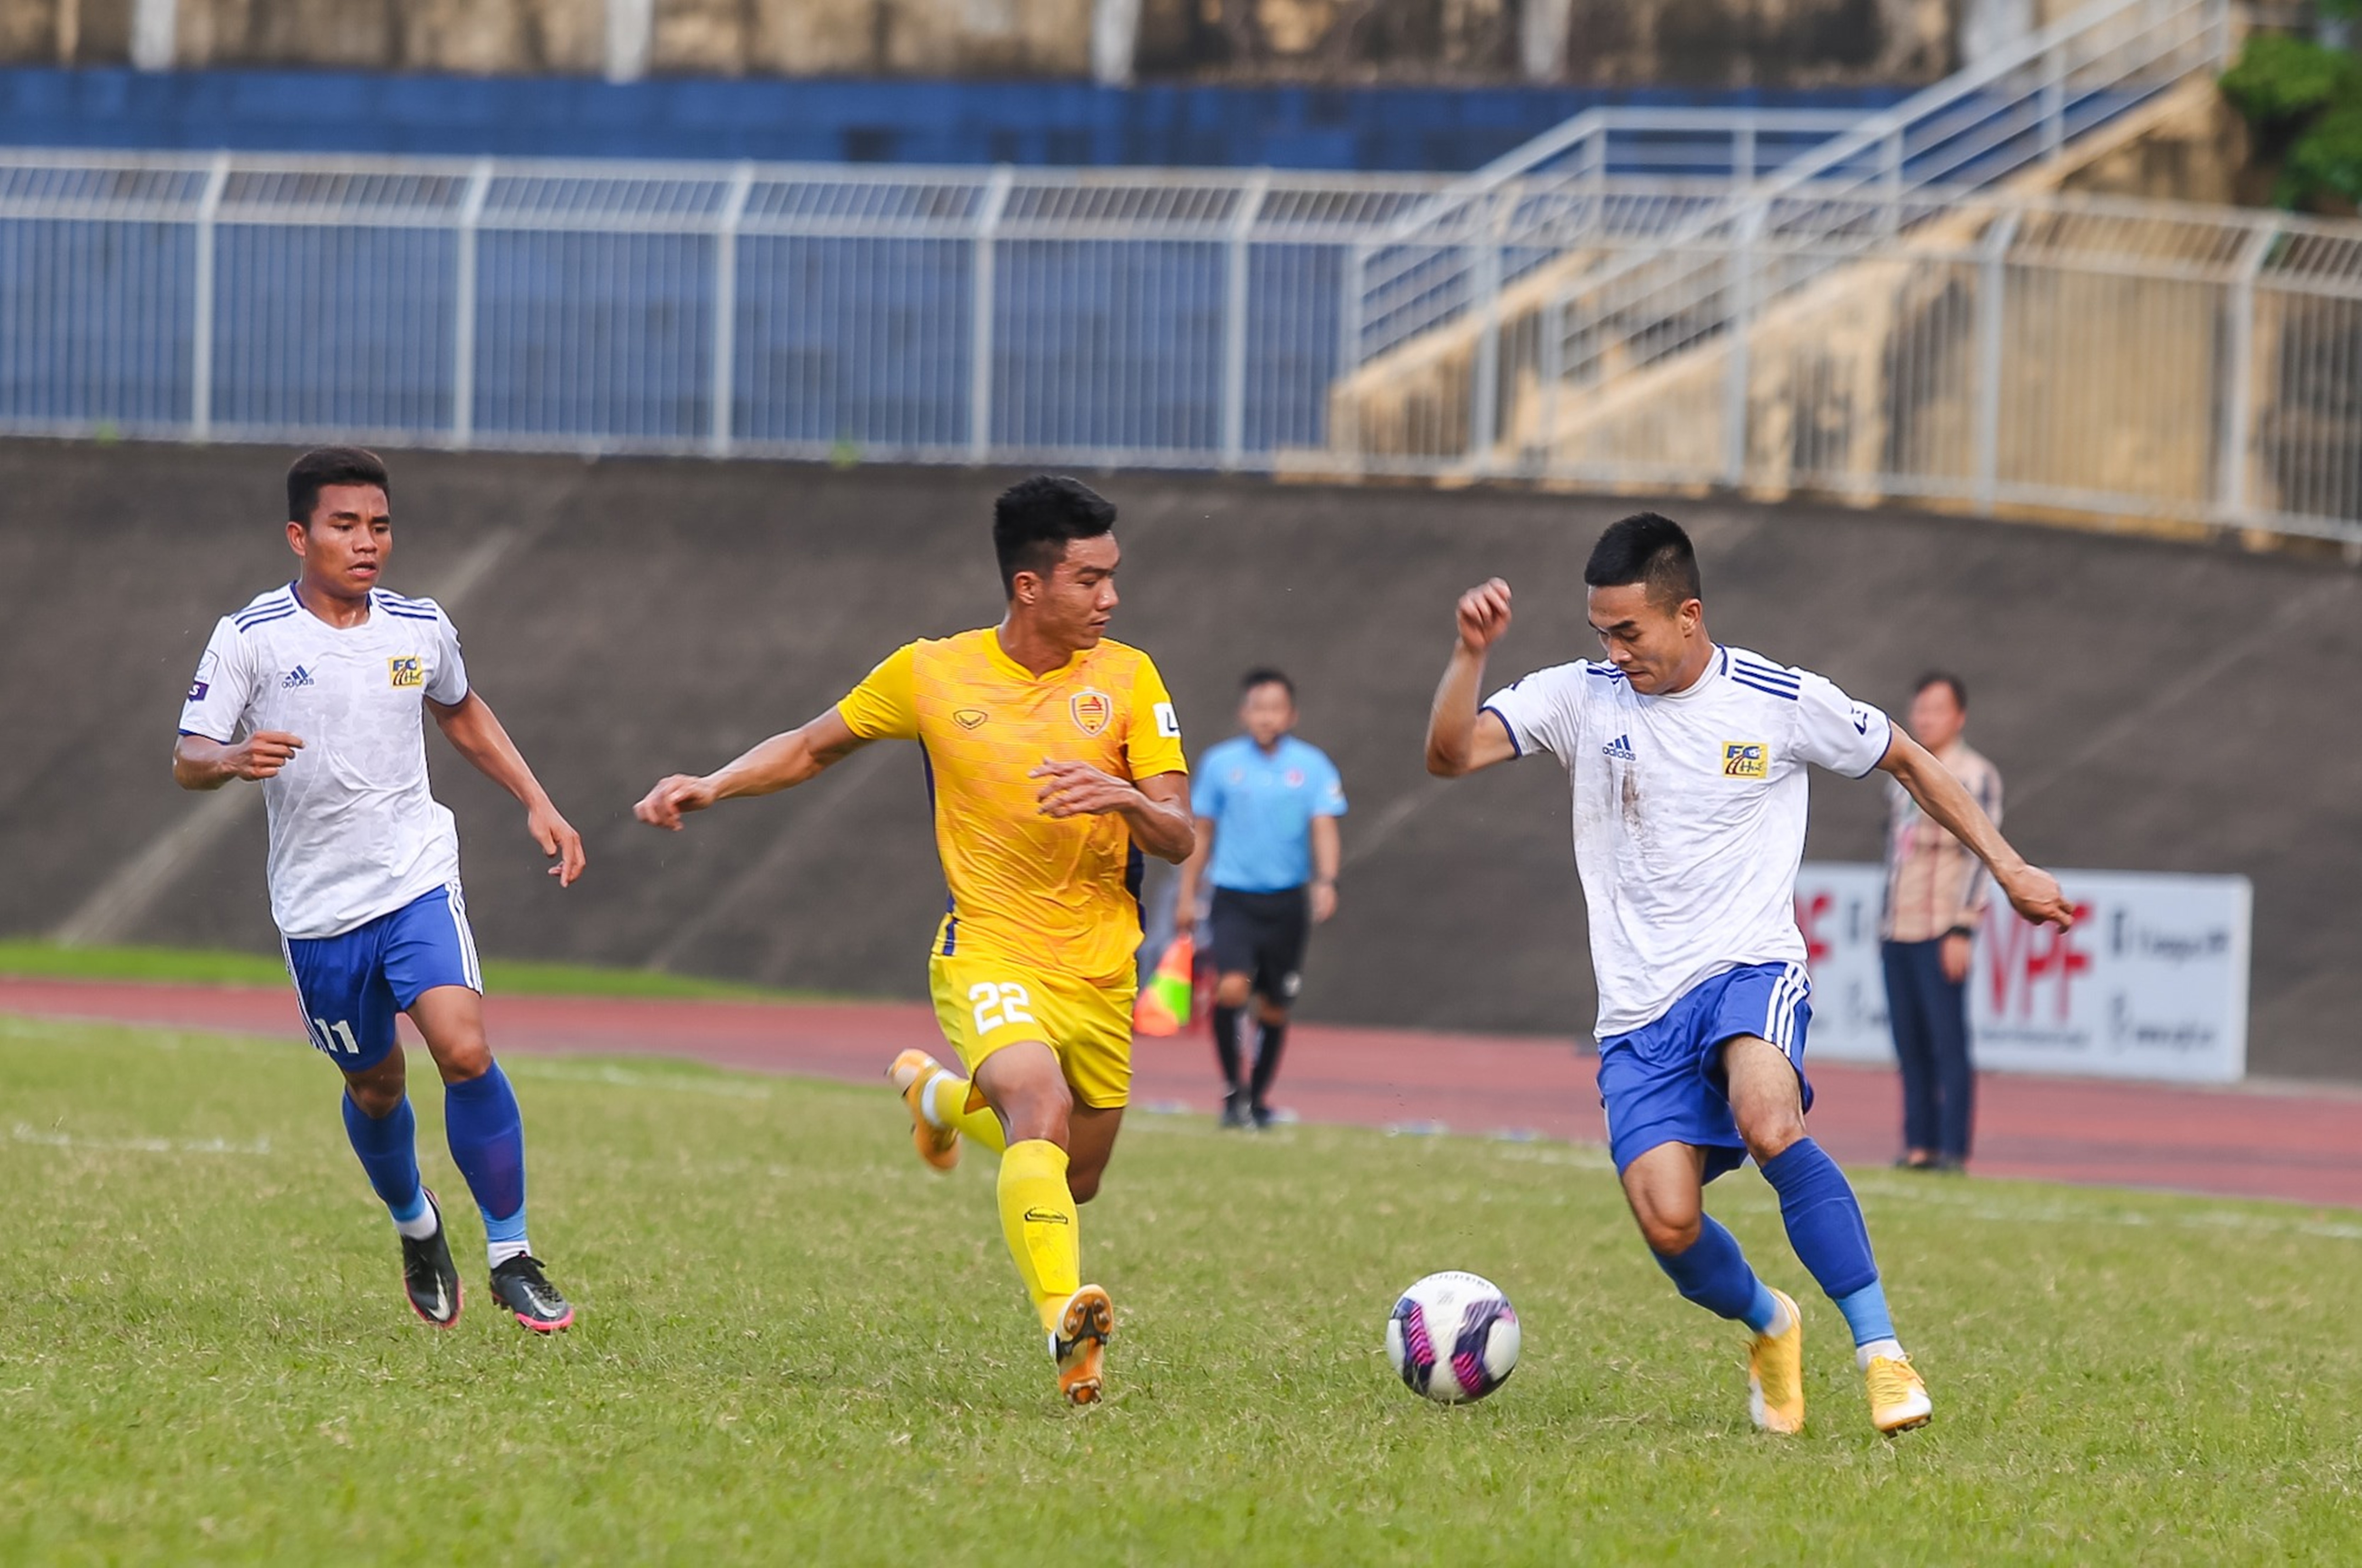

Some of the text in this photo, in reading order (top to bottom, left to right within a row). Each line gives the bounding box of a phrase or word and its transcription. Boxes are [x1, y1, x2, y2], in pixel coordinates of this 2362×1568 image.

[393, 658, 417, 671] FC
[1602, 746, 1636, 761] adidas
[1726, 745, 1760, 759] FC
[968, 982, 1036, 1036] 22
[314, 1017, 359, 1054] 11
